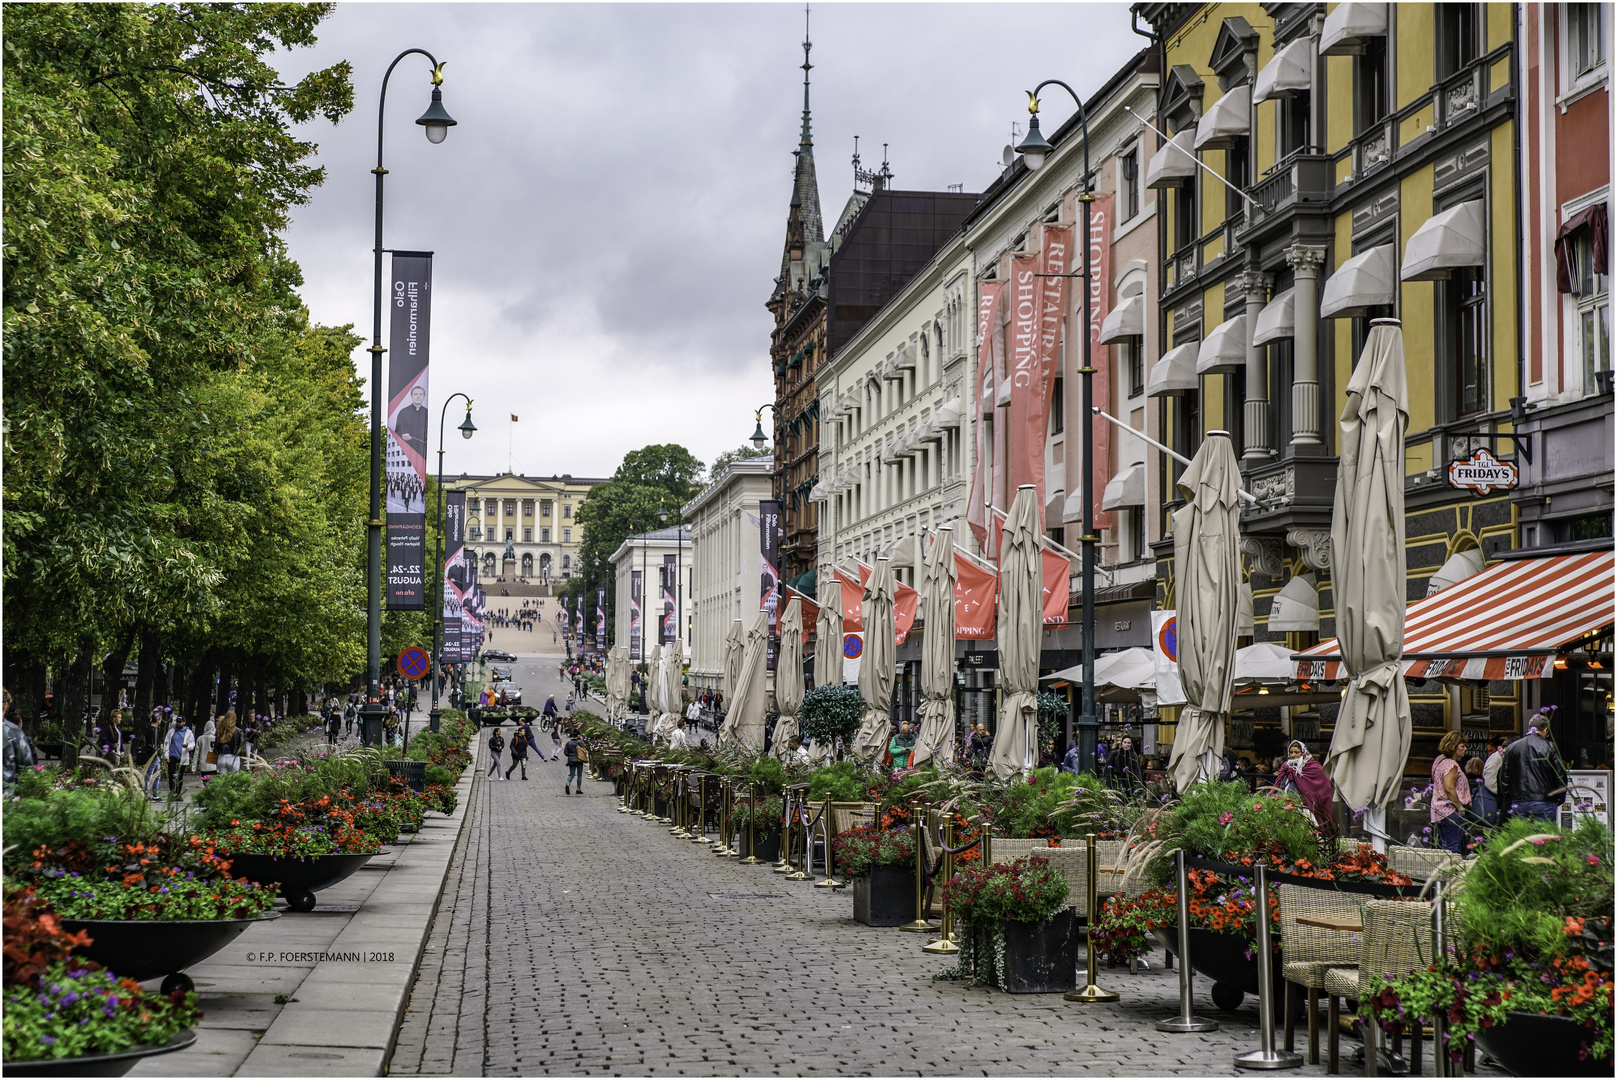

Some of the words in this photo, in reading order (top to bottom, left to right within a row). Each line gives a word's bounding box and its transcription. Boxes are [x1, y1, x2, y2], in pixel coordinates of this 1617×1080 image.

[1014, 270, 1034, 388] SHOPPING
[1457, 467, 1510, 479] FRIDAY'S
[1300, 661, 1325, 677] FRIDAYS
[1509, 656, 1547, 677] FRIDAYS
